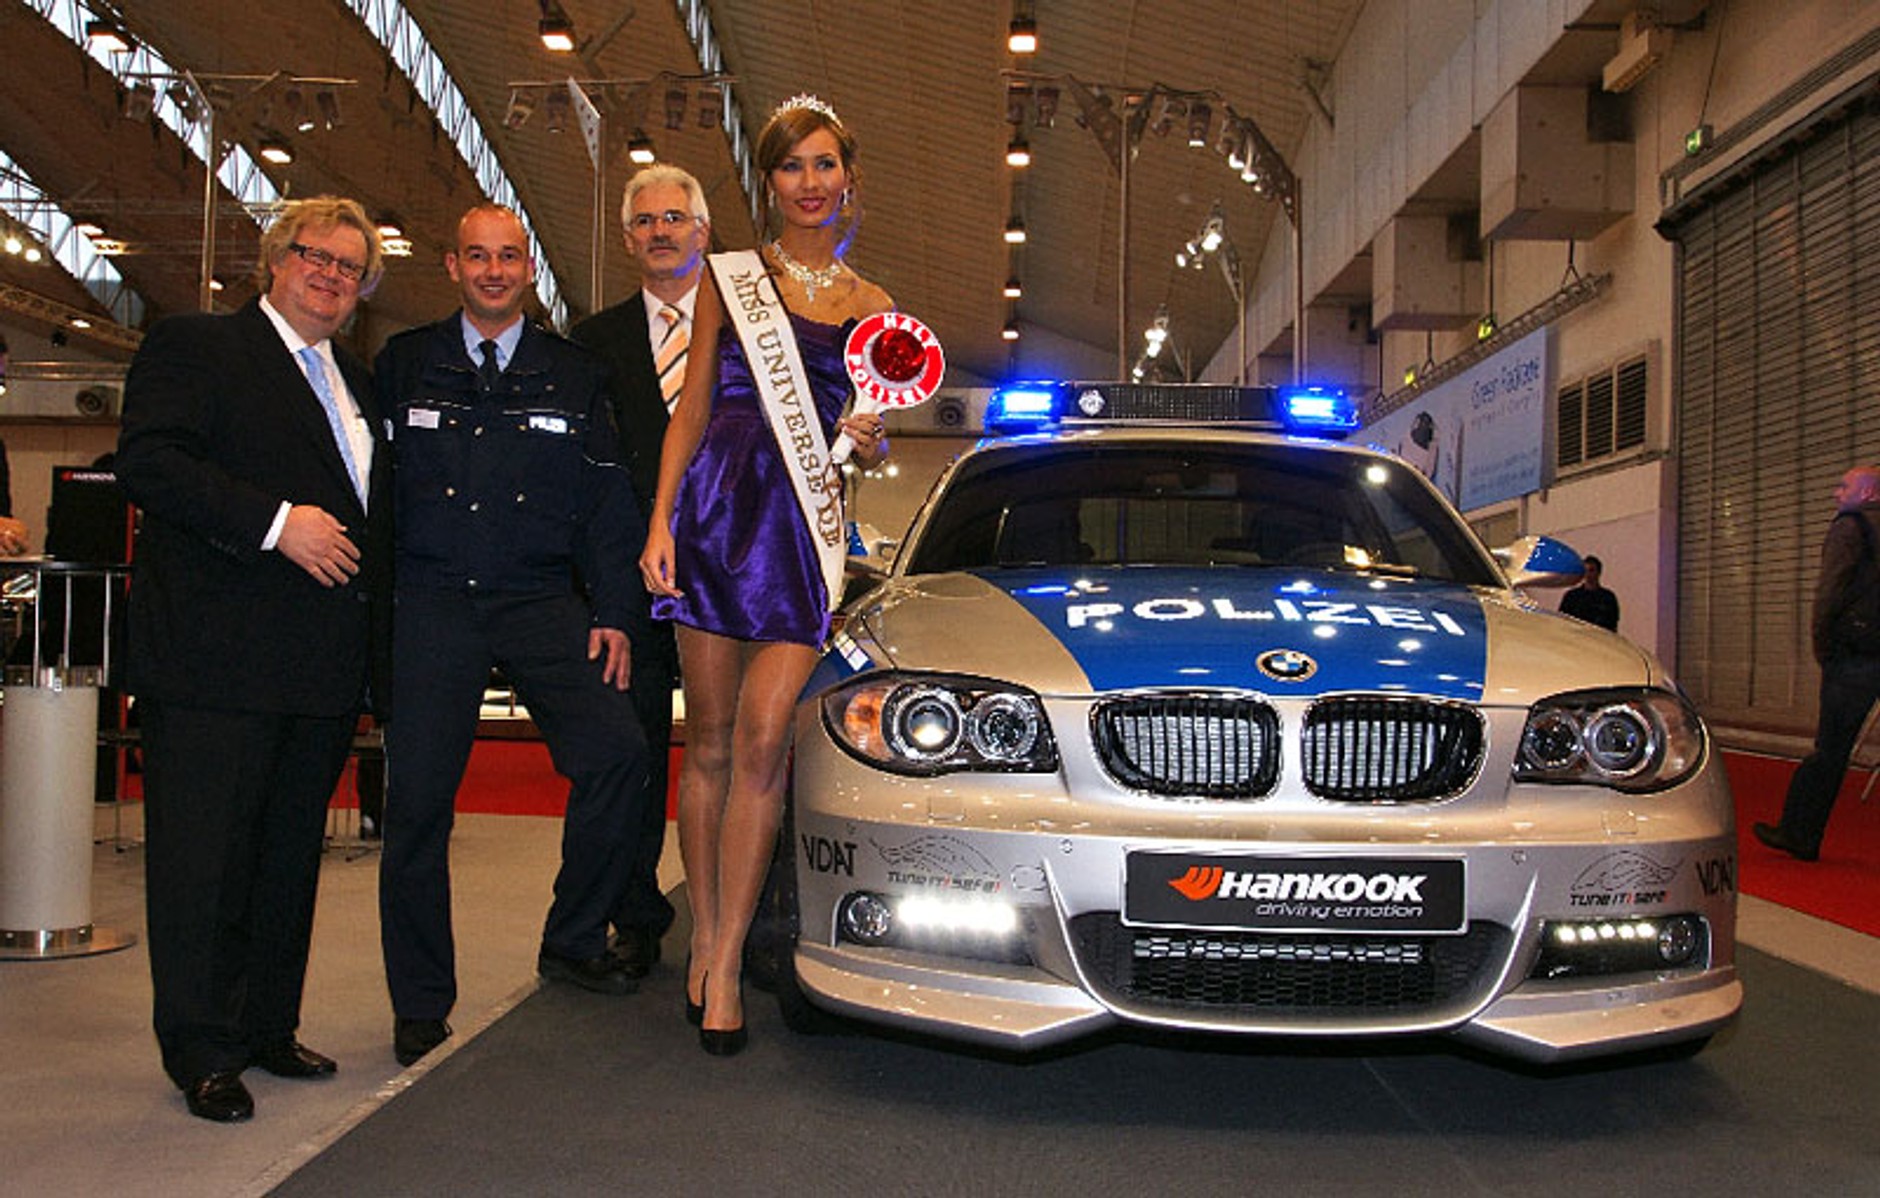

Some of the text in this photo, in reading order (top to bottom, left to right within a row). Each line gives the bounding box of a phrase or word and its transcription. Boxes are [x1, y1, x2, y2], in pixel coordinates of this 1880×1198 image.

[882, 312, 939, 349] HALT
[729, 270, 769, 324] MISS
[756, 328, 822, 494] UNIVERSE
[846, 354, 926, 406] POLIZEI
[1066, 598, 1466, 636] POLIZEI
[801, 833, 859, 878] VDAT
[1255, 902, 1424, 919] driving emotion
